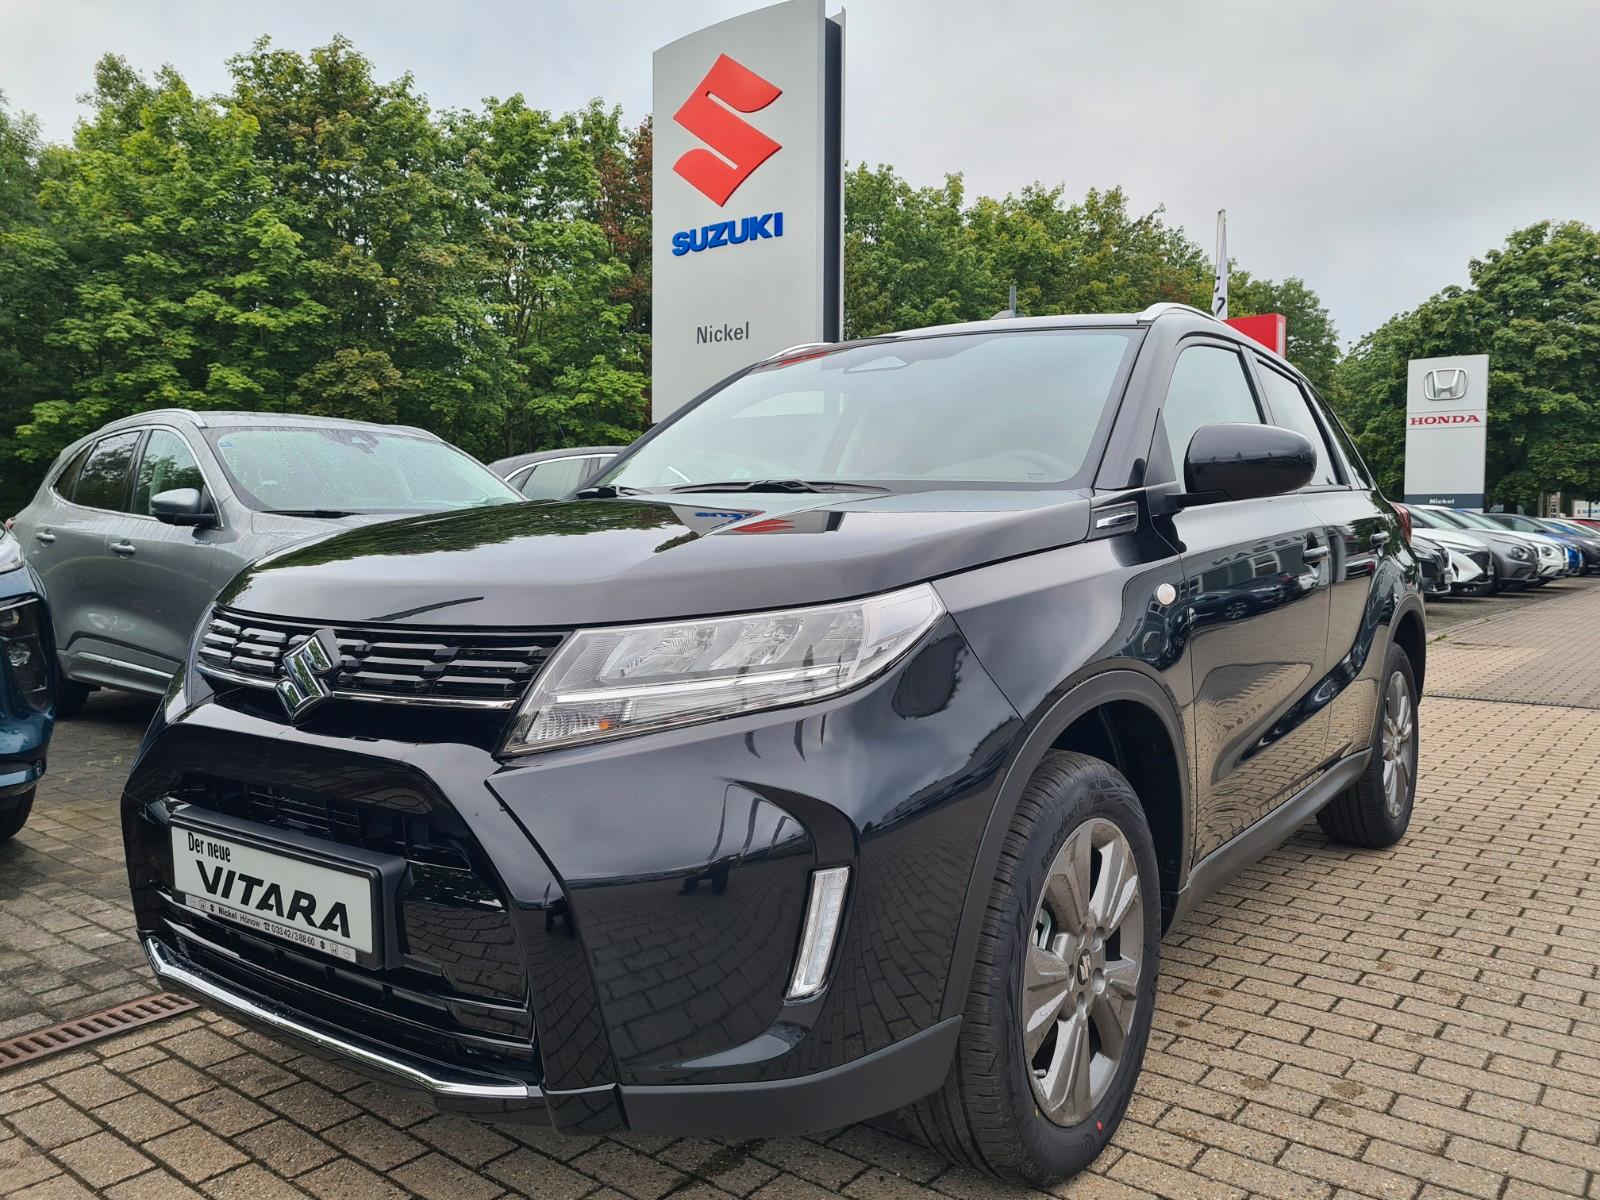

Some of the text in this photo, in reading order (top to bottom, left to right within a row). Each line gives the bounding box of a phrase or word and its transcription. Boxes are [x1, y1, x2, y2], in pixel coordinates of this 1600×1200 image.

[671, 212, 784, 257] SUZUKI
[696, 321, 749, 344] Nickel
[1410, 415, 1480, 425] HONDA
[187, 831, 231, 863] Der neue
[195, 859, 351, 939] VITARA
[218, 906, 238, 921] Nickel
[239, 912, 261, 928] Hönow
